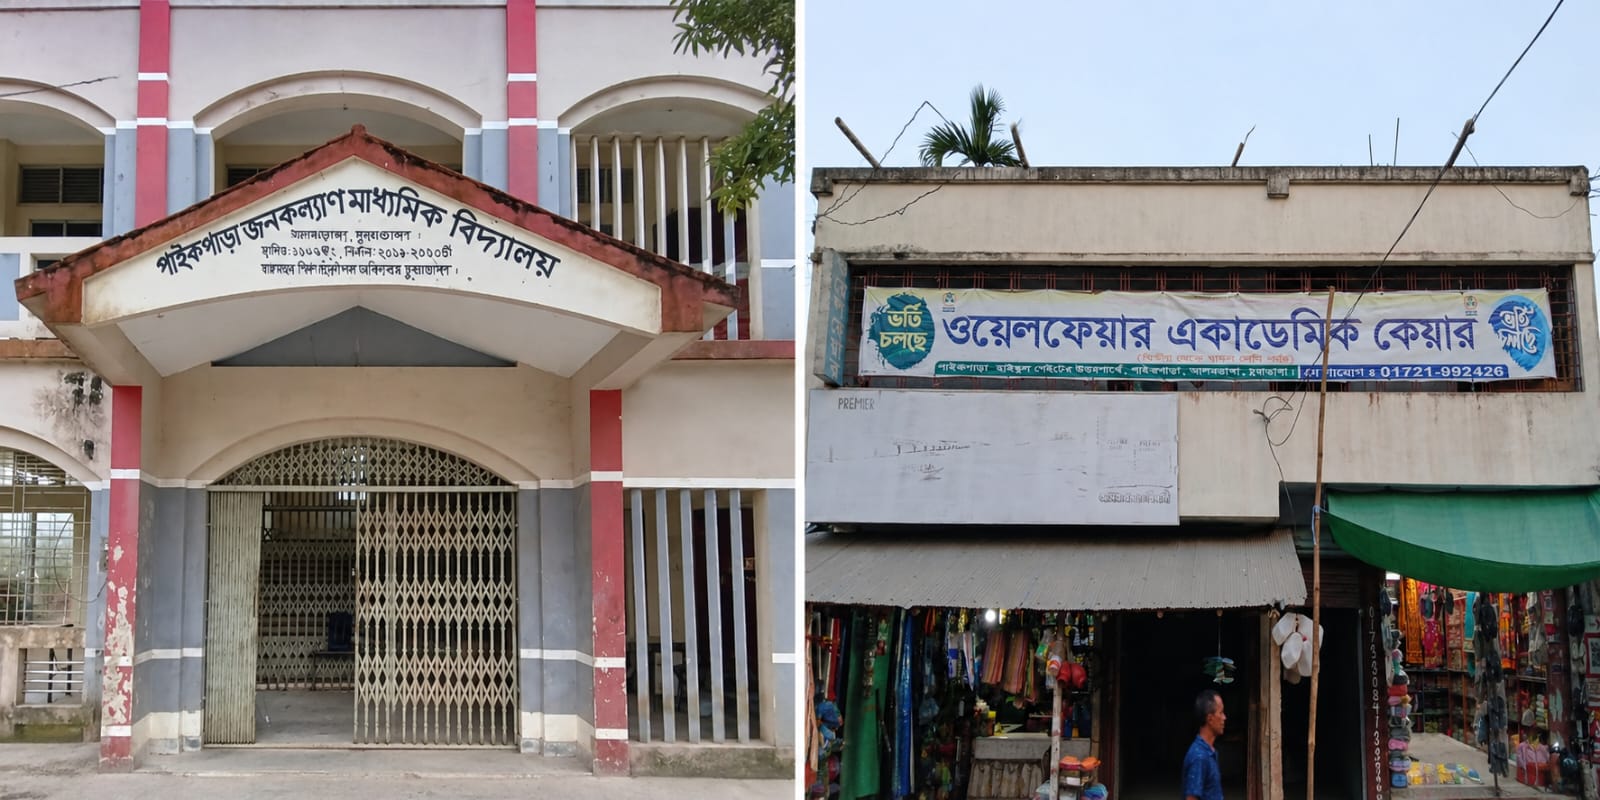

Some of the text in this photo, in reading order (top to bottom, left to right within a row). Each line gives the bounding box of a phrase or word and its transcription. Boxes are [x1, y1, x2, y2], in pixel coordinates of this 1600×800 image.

[156, 186, 561, 279] পাইকপাড়া জনকল্যাণ মাধ্যমিক বিদ্যালয়
[887, 303, 922, 328] ভর্তি
[942, 307, 1479, 351] ওয়েলফেয়ার একাডেমিক কেয়ার
[880, 331, 928, 353] চলছে
[1380, 365, 1505, 378] 01721-992426
[837, 397, 875, 410] PREMIER
